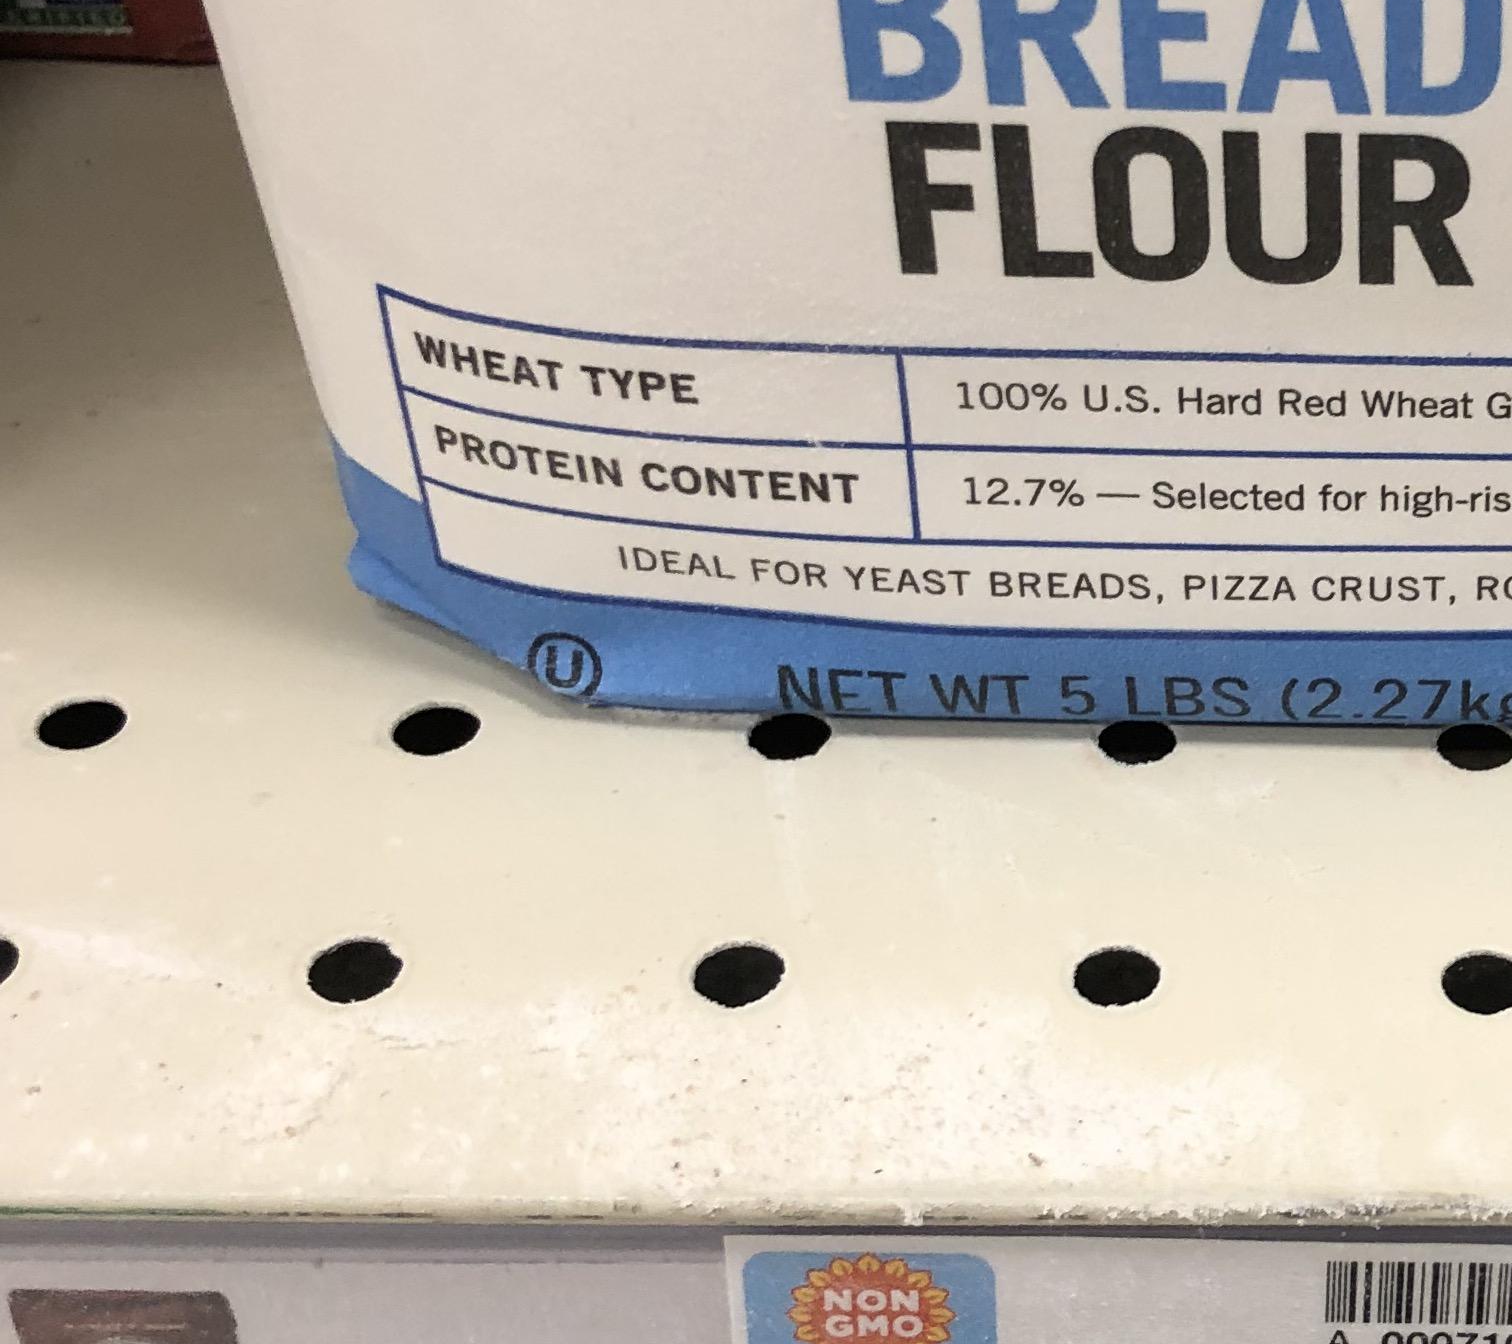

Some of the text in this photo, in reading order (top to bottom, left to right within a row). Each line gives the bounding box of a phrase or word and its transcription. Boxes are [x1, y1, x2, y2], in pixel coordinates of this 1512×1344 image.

[884, 120, 1475, 287] FLOUR
[413, 330, 699, 405] WHEAT TYPE
[956, 380, 1068, 413] 100%
[1082, 383, 1161, 414] U.S.
[1177, 384, 1262, 417] Hard
[1277, 387, 1346, 418] Red
[1361, 389, 1474, 420] Wheat
[432, 422, 860, 505] PROTEIN CONTENT
[962, 475, 1086, 508] 12.7%
[1152, 481, 1305, 513] Selected
[1318, 483, 1368, 512] for
[616, 545, 736, 581] IDEAL
[751, 557, 829, 589] FOR
[843, 566, 971, 598] YEAST
[989, 570, 1165, 606] BREADS,
[1182, 574, 1297, 603] PIZZA
[1311, 574, 1458, 606] CRUST,
[776, 664, 907, 715] NET
[929, 673, 1030, 717] WT
[1060, 675, 1098, 717] 5
[1125, 675, 1252, 720] LBS
[823, 1287, 920, 1313] NON
[824, 1314, 924, 1340] GMO
